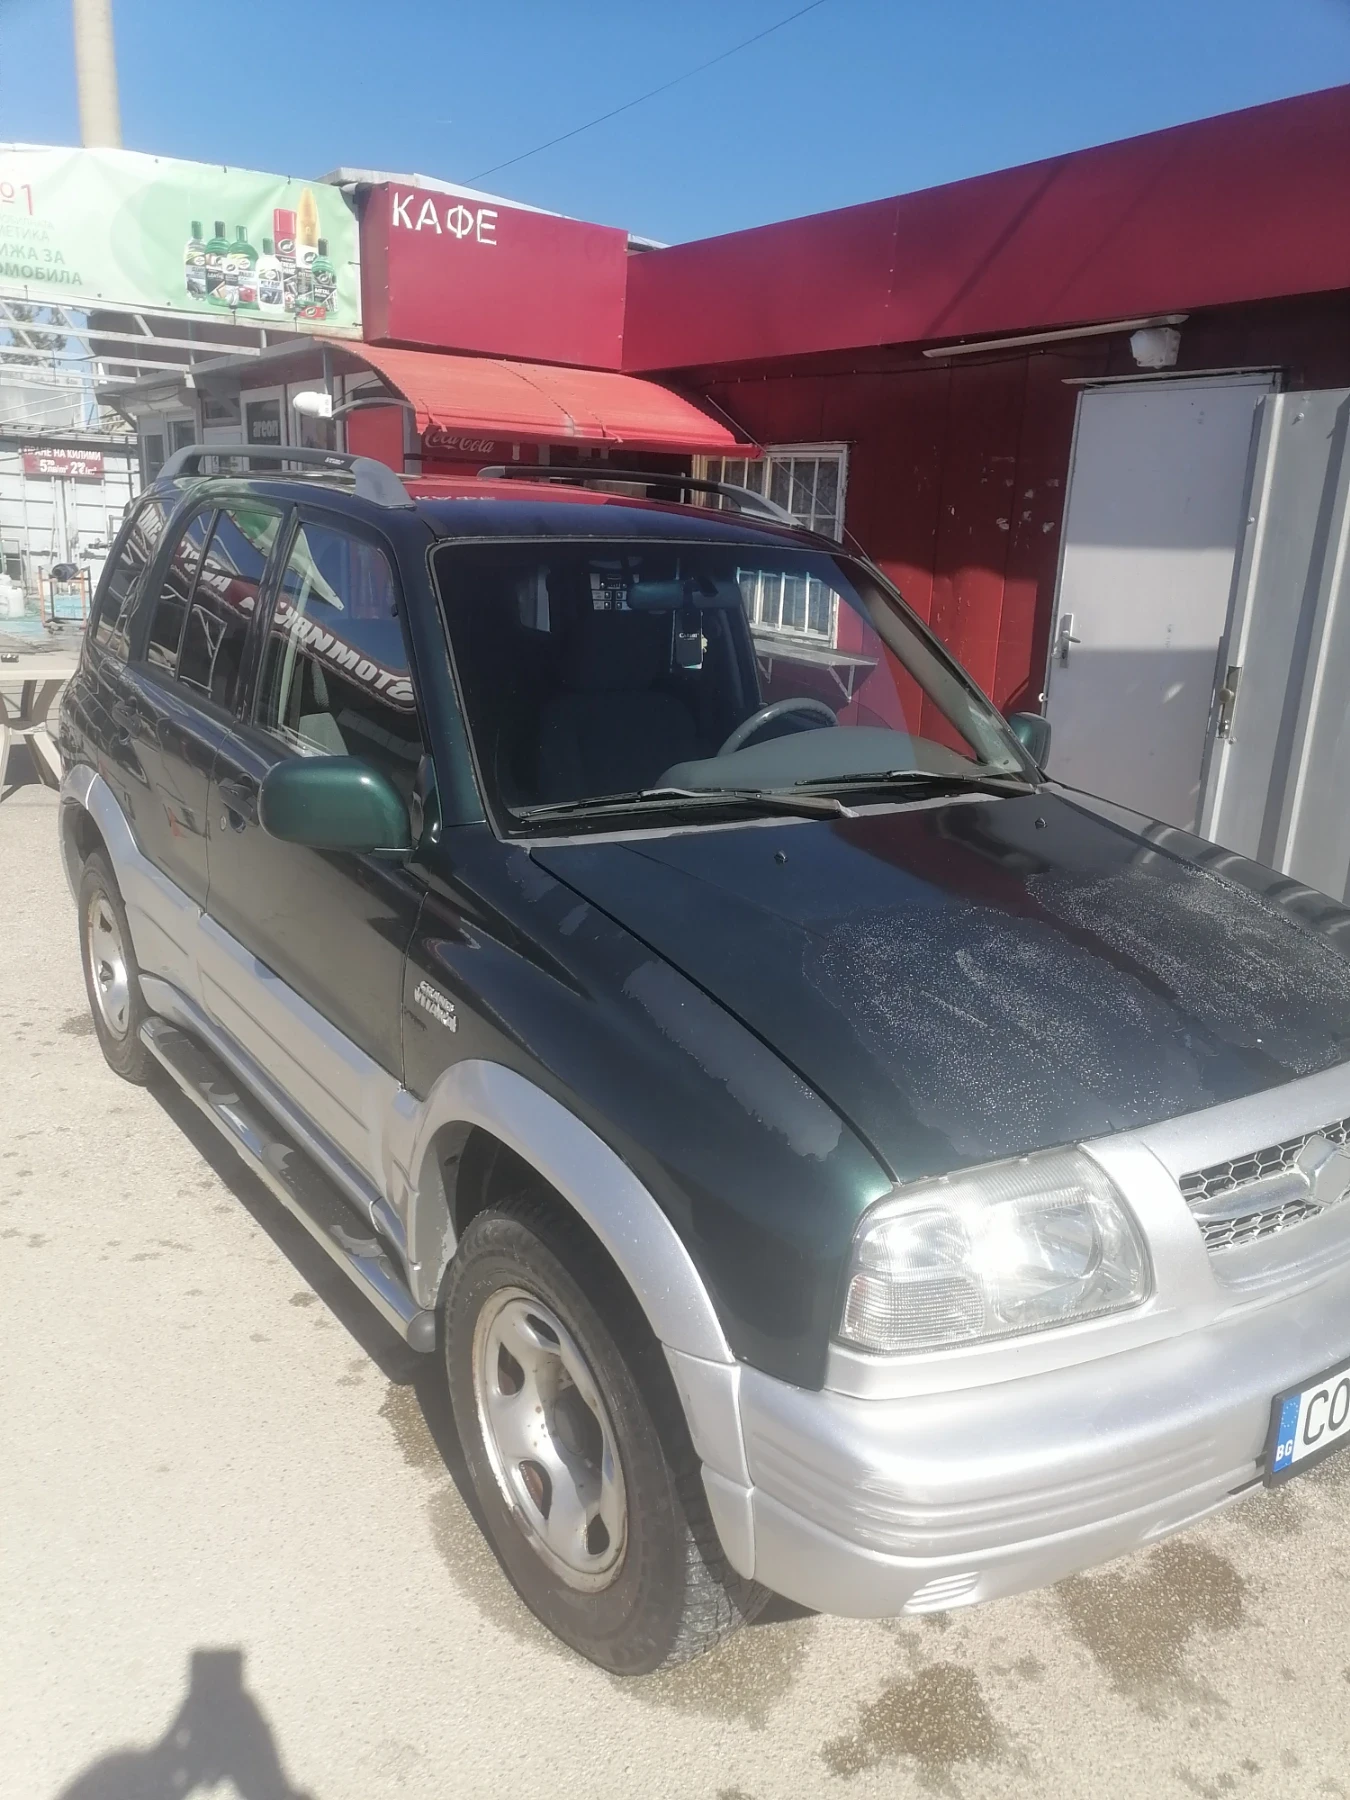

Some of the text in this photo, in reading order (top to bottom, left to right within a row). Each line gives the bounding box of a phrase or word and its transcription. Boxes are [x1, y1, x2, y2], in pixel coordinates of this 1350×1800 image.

[391, 192, 499, 246] КАФЕ
[42, 248, 65, 265] ЗА
[253, 420, 279, 438] areon
[52, 448, 67, 459] НА
[67, 449, 102, 461] КИЛИМИ
[420, 981, 455, 1012] GRAND
[1275, 1439, 1294, 1462] BG
